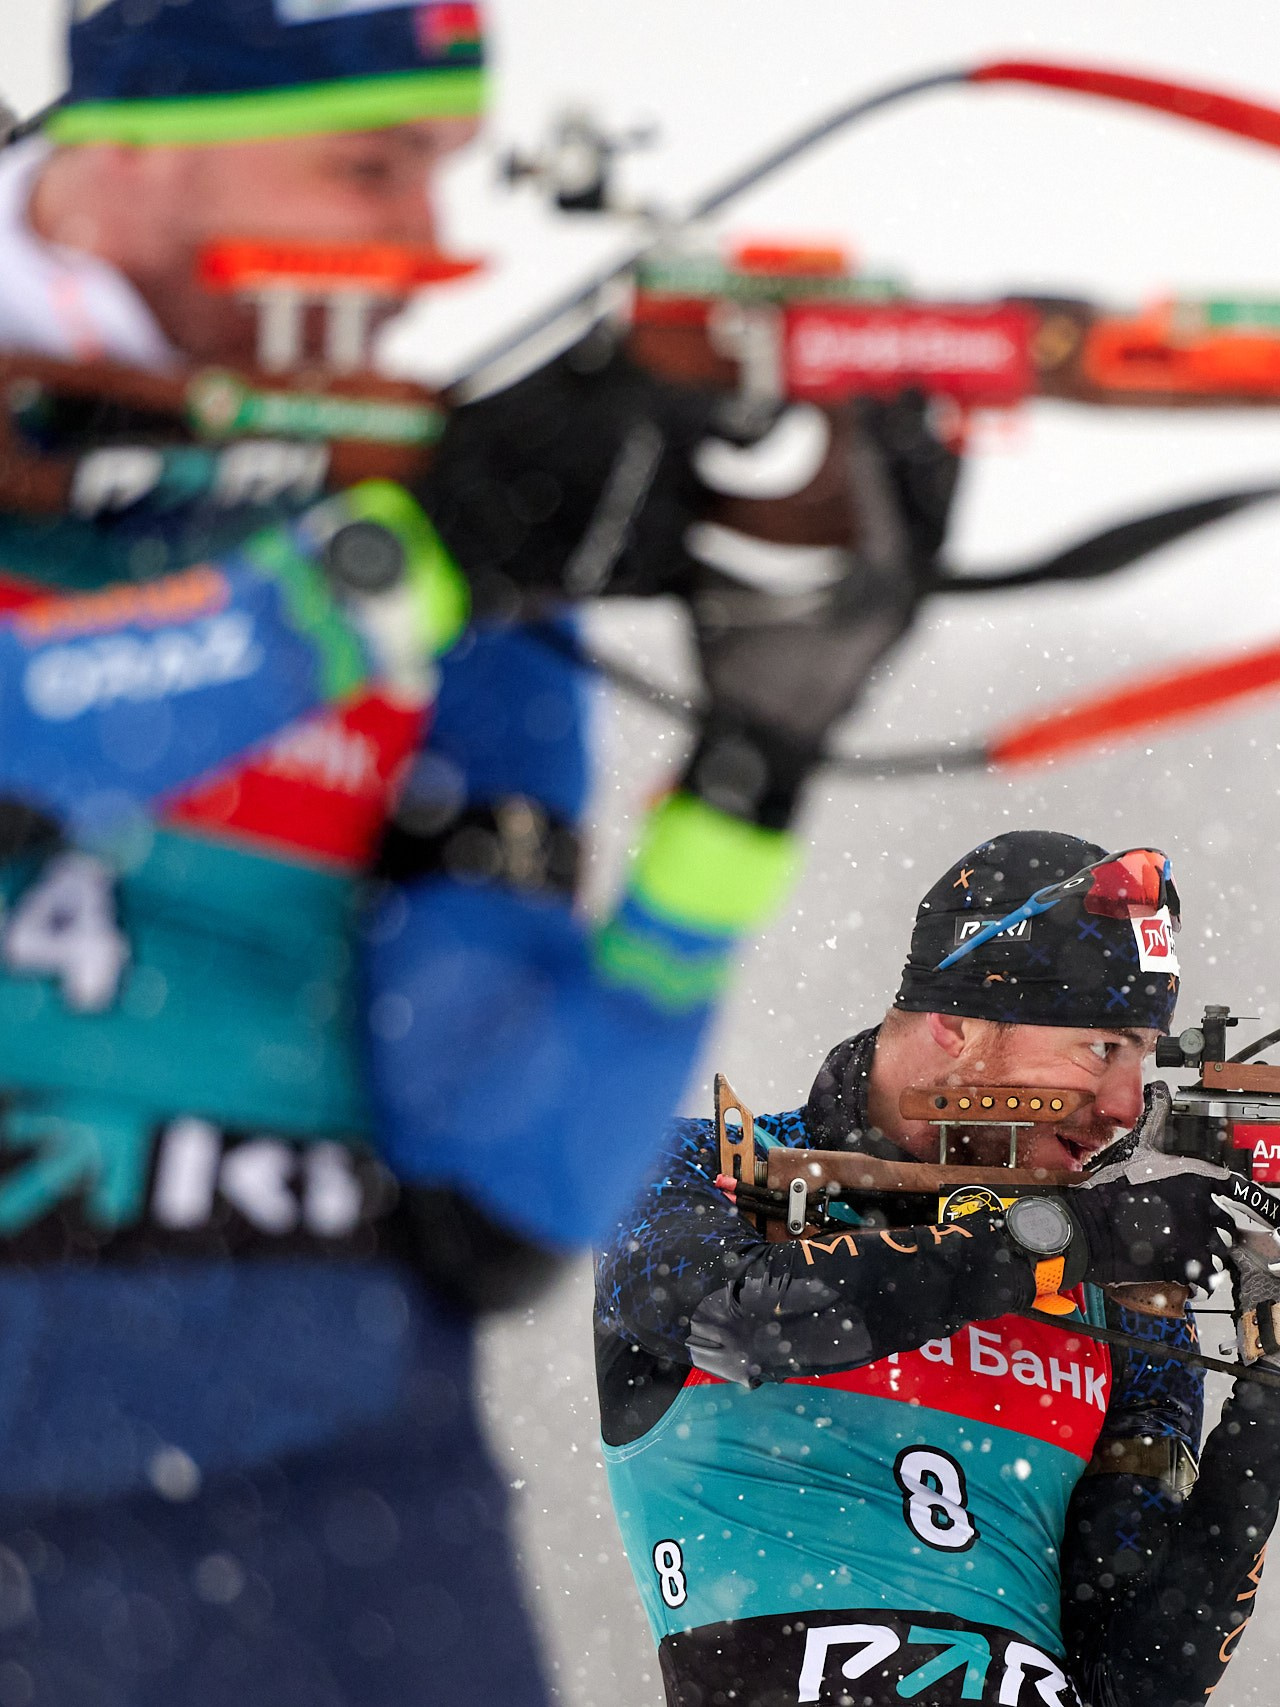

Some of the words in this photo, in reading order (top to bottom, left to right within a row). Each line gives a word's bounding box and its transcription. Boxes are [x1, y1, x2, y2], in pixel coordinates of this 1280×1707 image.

[1234, 1181, 1279, 1220] MOAX
[969, 1325, 1107, 1413] Банк
[896, 1447, 978, 1550] 8
[653, 1540, 687, 1608] 8
[798, 1624, 1084, 1707] PAR
